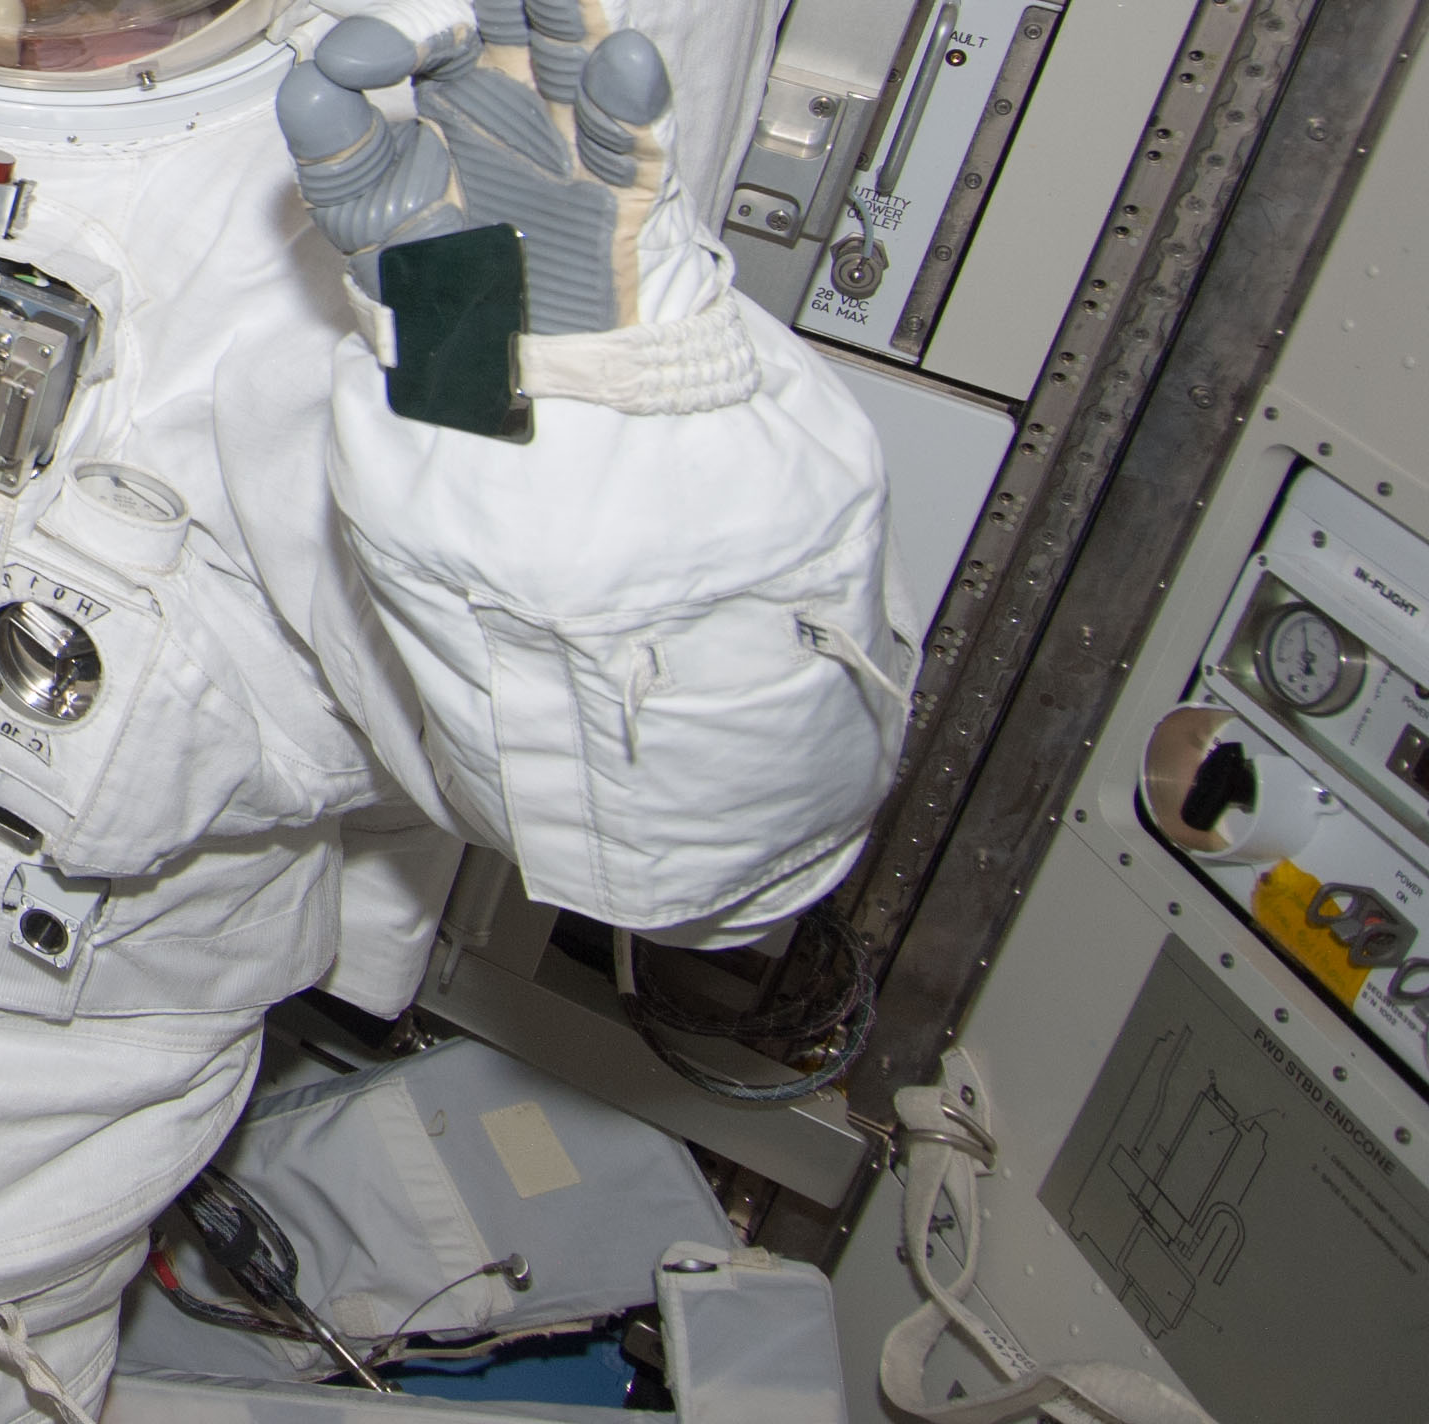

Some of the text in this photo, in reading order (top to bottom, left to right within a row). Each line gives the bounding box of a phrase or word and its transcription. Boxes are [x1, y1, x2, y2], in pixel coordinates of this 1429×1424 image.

[949, 31, 988, 48] AULT
[854, 188, 911, 210] UTILITY
[847, 208, 902, 231] OULET
[859, 201, 903, 221] OWER
[816, 288, 870, 312] 28 VDC
[811, 299, 869, 325] 6A MAX
[1354, 566, 1419, 617] IN-FLIGHT
[1395, 870, 1423, 897] POWER
[1396, 890, 1408, 904] ON
[1253, 1028, 1398, 1176] FWD STBD ENDCONE
